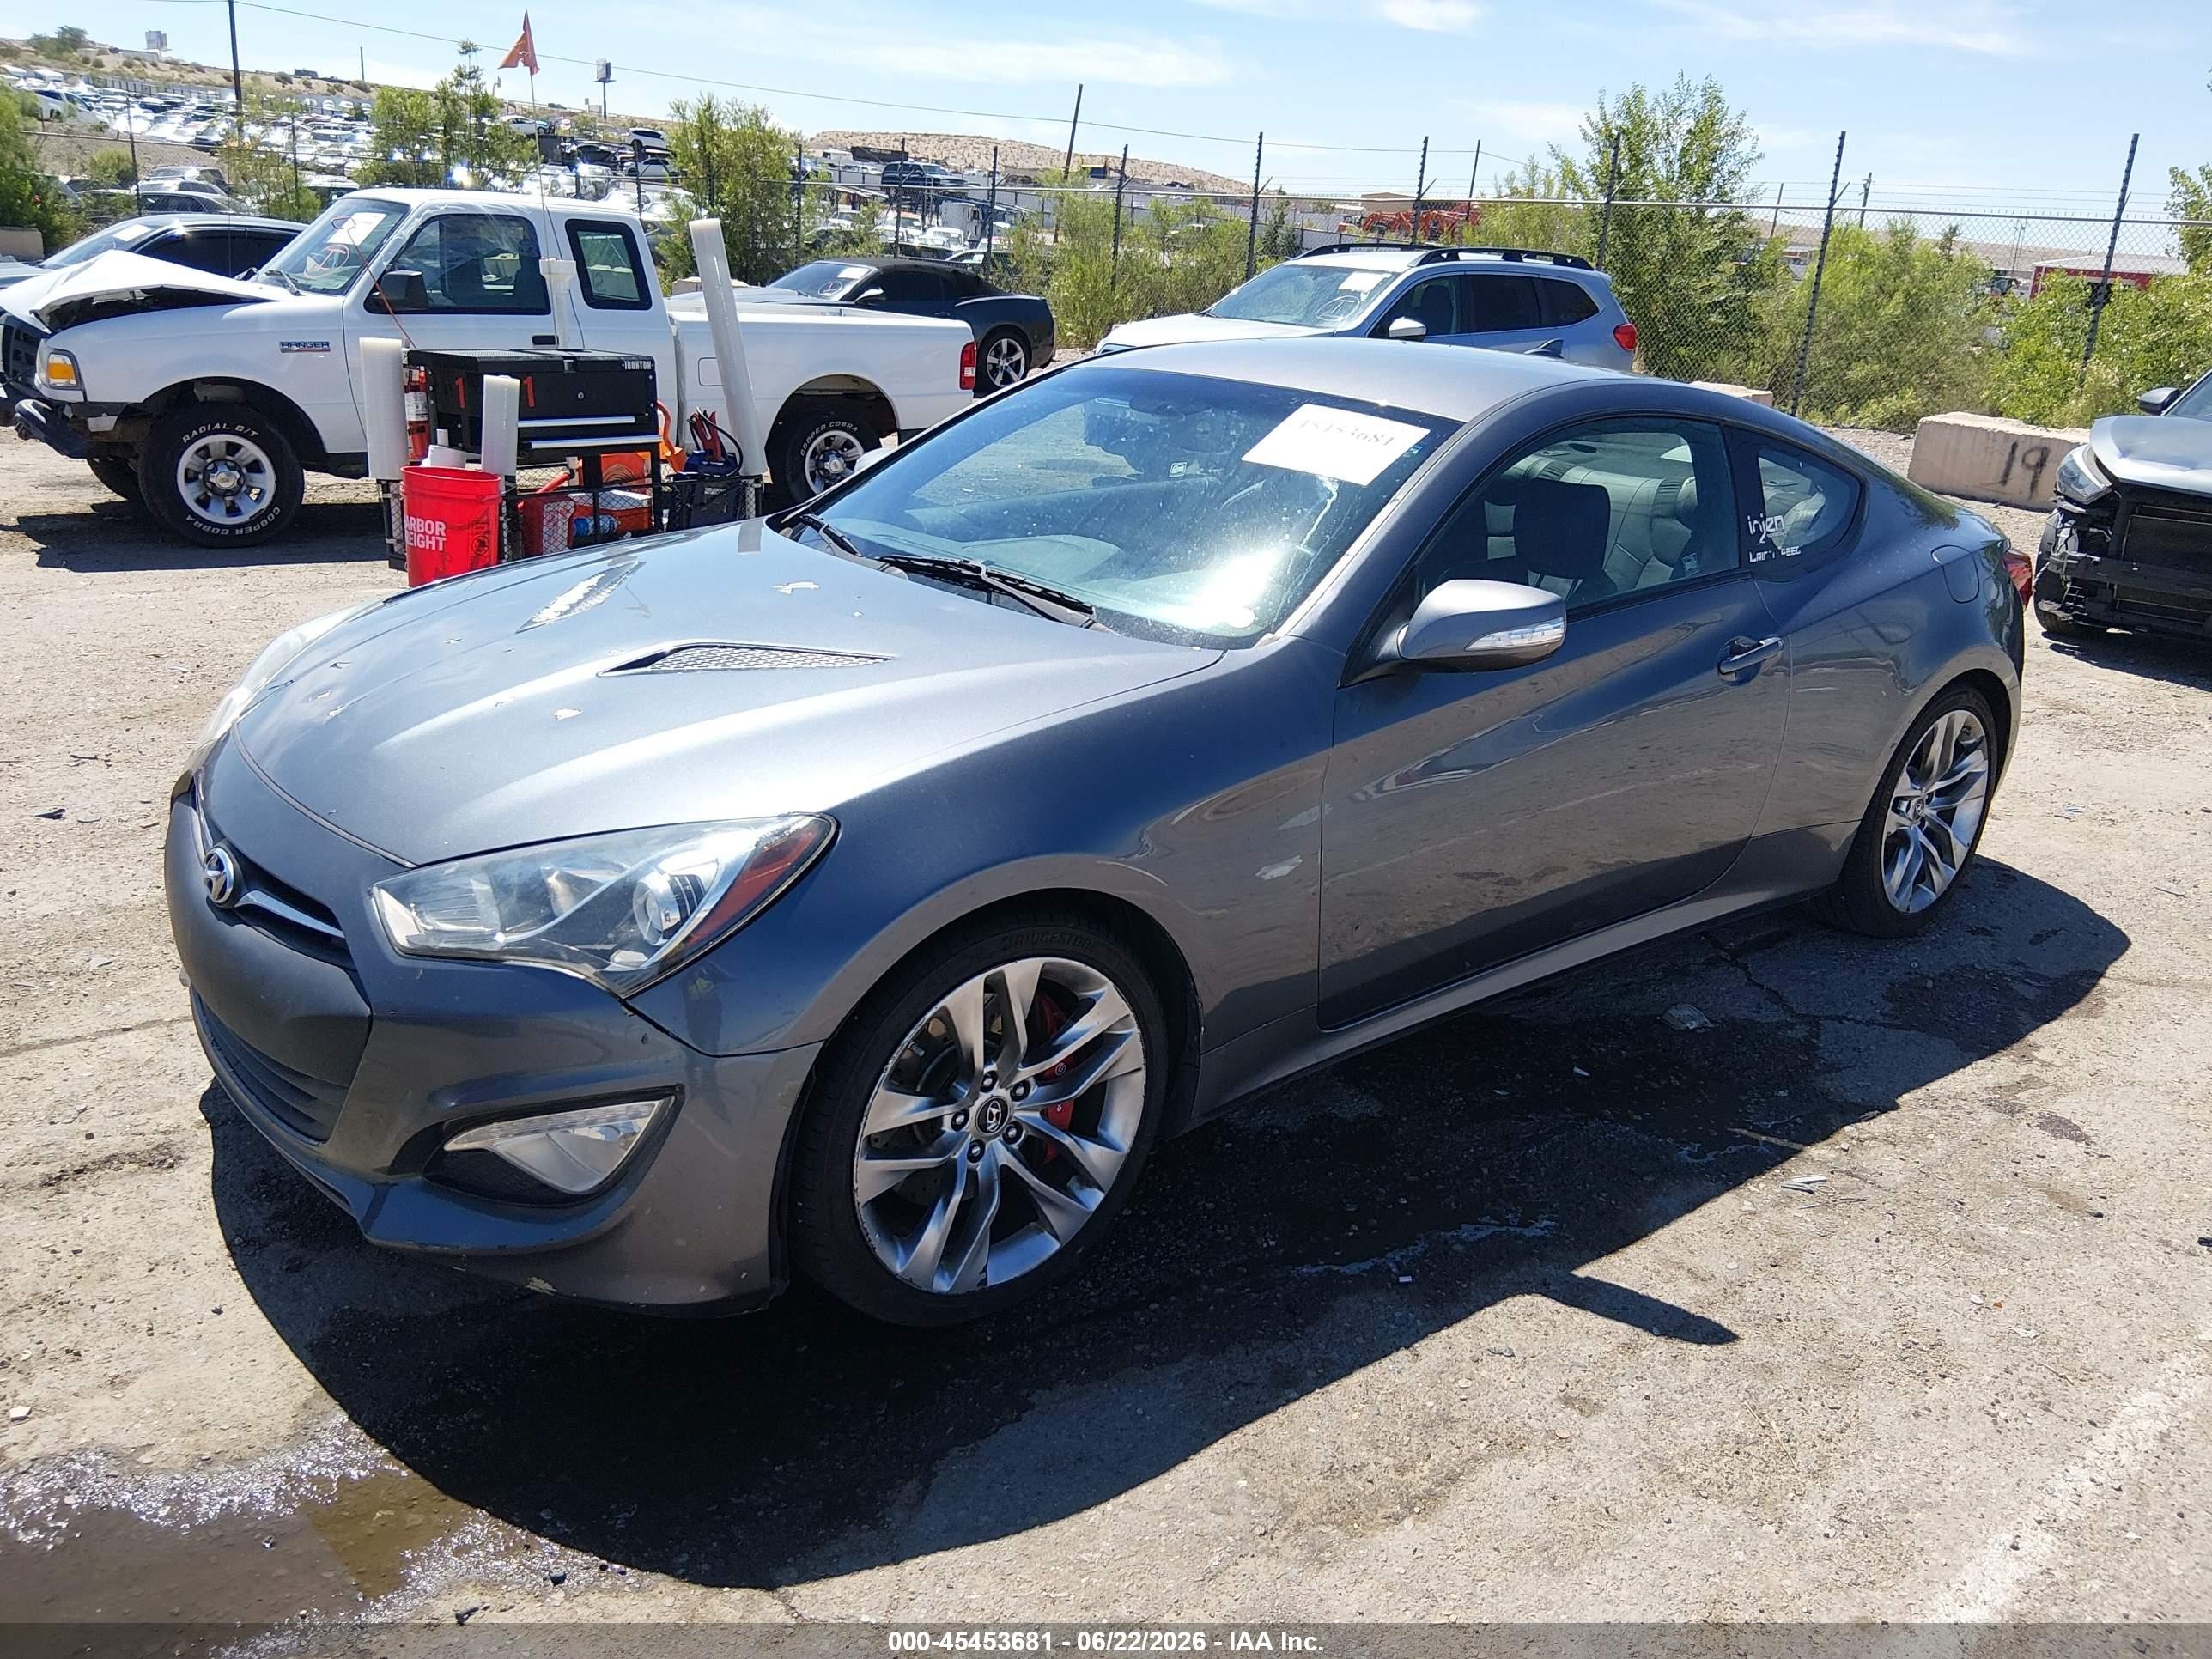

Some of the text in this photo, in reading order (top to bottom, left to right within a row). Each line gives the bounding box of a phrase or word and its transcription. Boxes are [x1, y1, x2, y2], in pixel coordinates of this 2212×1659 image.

[280, 341, 330, 349] RANGER
[624, 360, 652, 370] IRONTON
[522, 375, 536, 408] 1
[182, 422, 231, 443] RADIAL
[799, 421, 859, 456] COOPER COBRA
[1998, 441, 2051, 501] 19
[185, 507, 281, 535] COOPER COBRA
[404, 515, 447, 537] ARBOR
